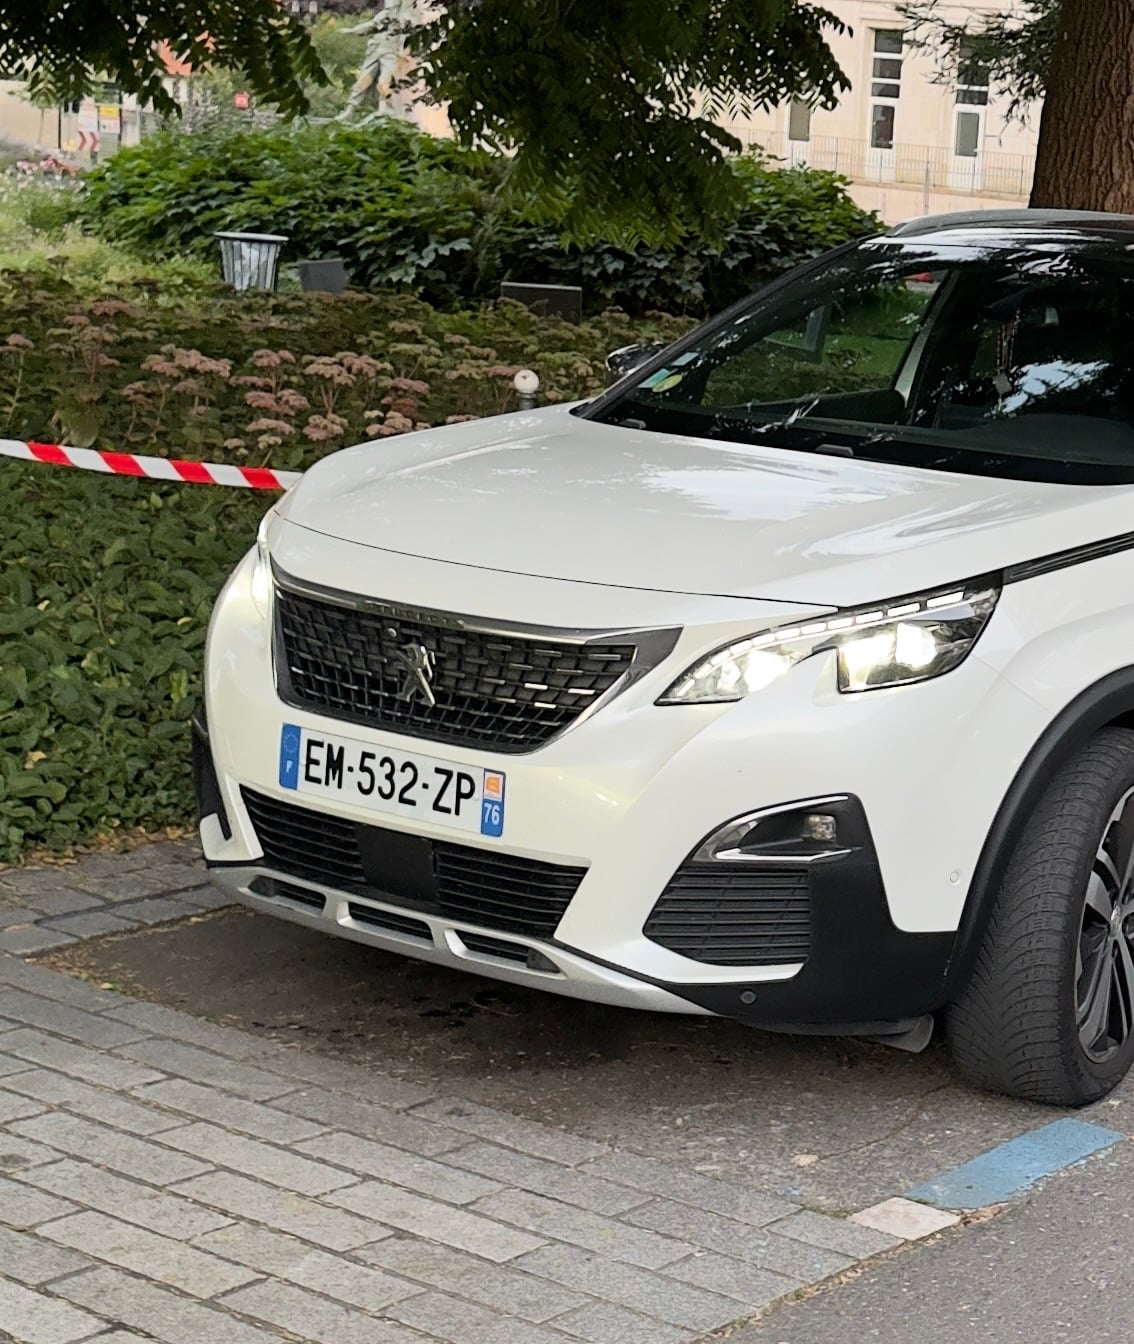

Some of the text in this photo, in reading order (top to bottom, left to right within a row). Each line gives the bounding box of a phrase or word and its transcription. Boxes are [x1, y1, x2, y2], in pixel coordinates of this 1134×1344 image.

[286, 759, 293, 773] F
[304, 738, 476, 816] EM-532-ZP
[484, 802, 500, 826] 76
